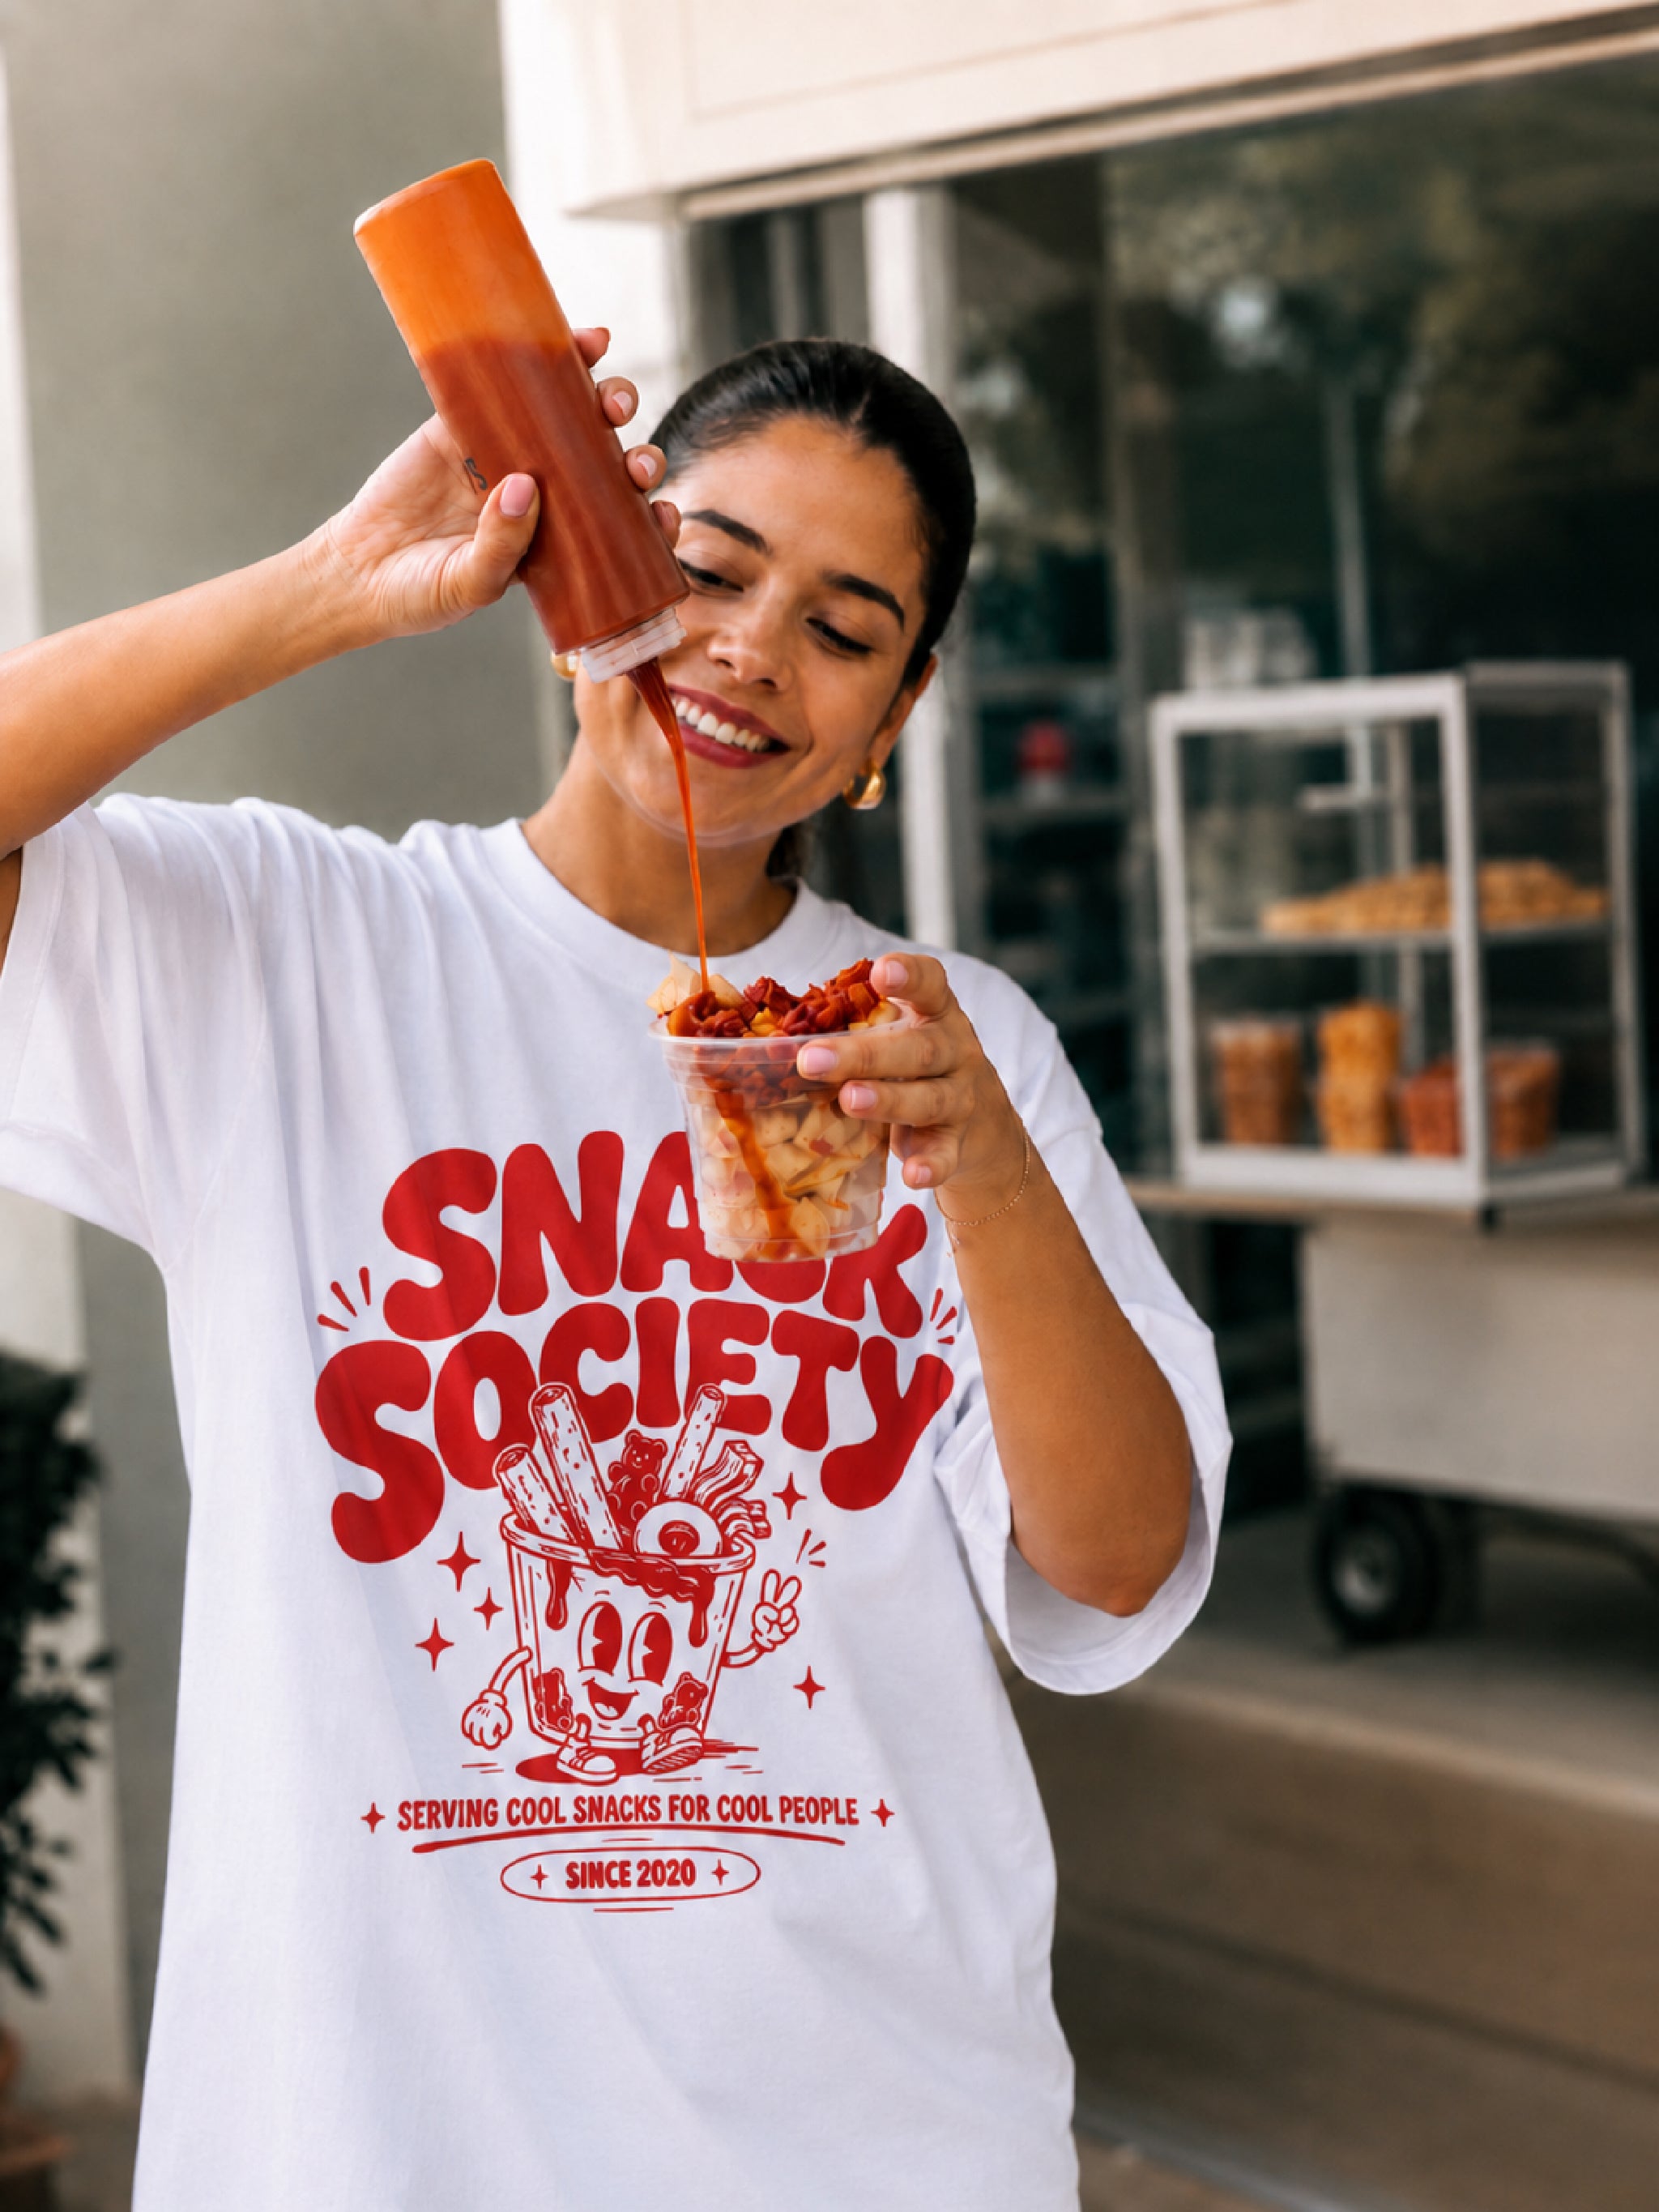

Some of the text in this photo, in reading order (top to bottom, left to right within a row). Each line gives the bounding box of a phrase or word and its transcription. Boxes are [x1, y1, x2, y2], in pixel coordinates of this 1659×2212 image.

[382, 1130, 928, 1342] SNAK
[315, 1296, 954, 1564] SOCIETY
[397, 1794, 859, 1831] SERVING COOL SNACKS FOR COOL PEOPLE
[565, 1858, 697, 1890] SINCE 2020
